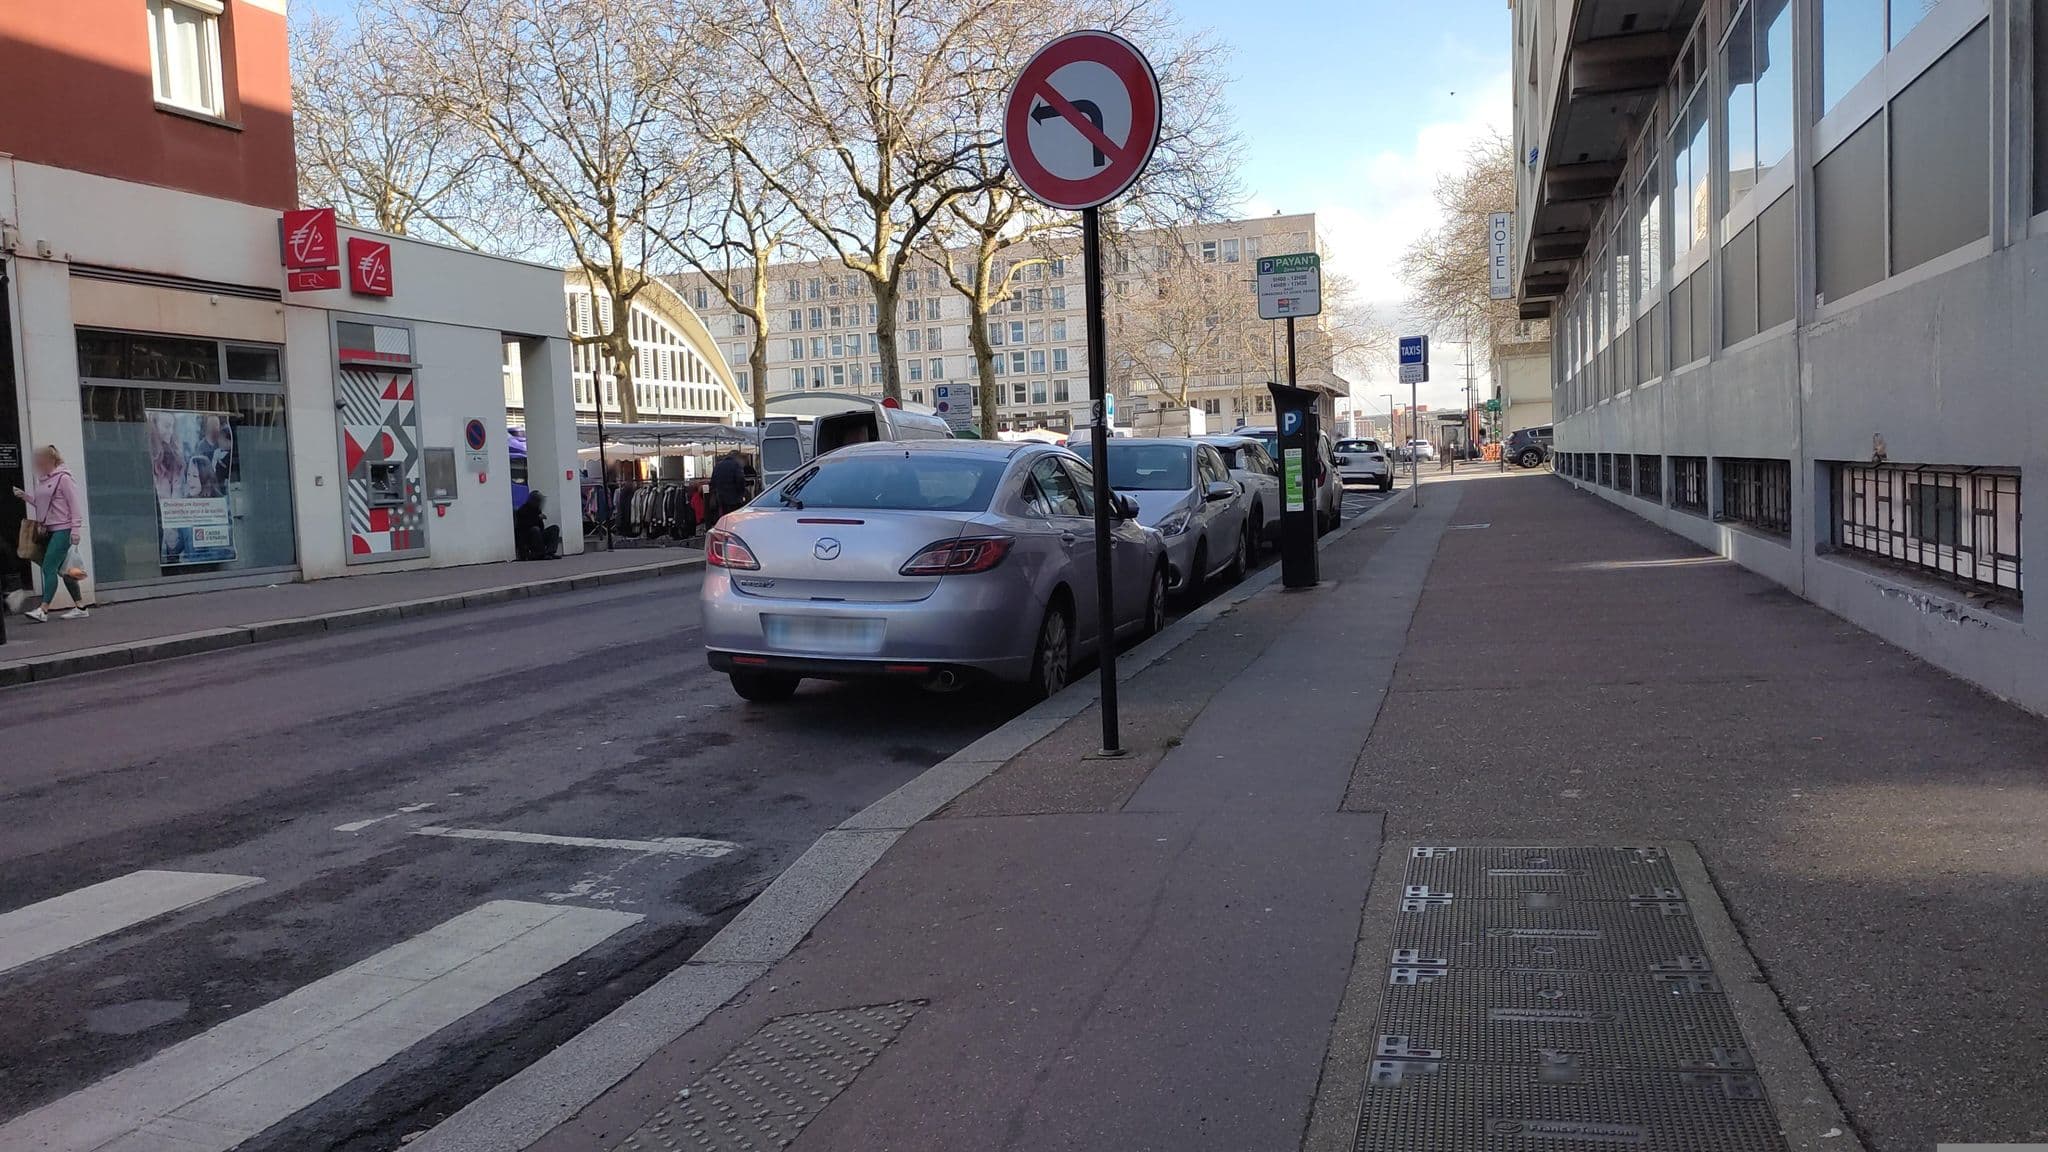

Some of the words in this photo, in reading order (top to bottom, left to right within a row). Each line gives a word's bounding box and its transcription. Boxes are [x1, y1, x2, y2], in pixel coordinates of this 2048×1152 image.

[1494, 217, 1506, 280] HOTEL
[1276, 255, 1316, 267] PAYANT
[1401, 345, 1421, 356] TAXIS
[1284, 412, 1297, 432] P
[1529, 1124, 1576, 1134] France
